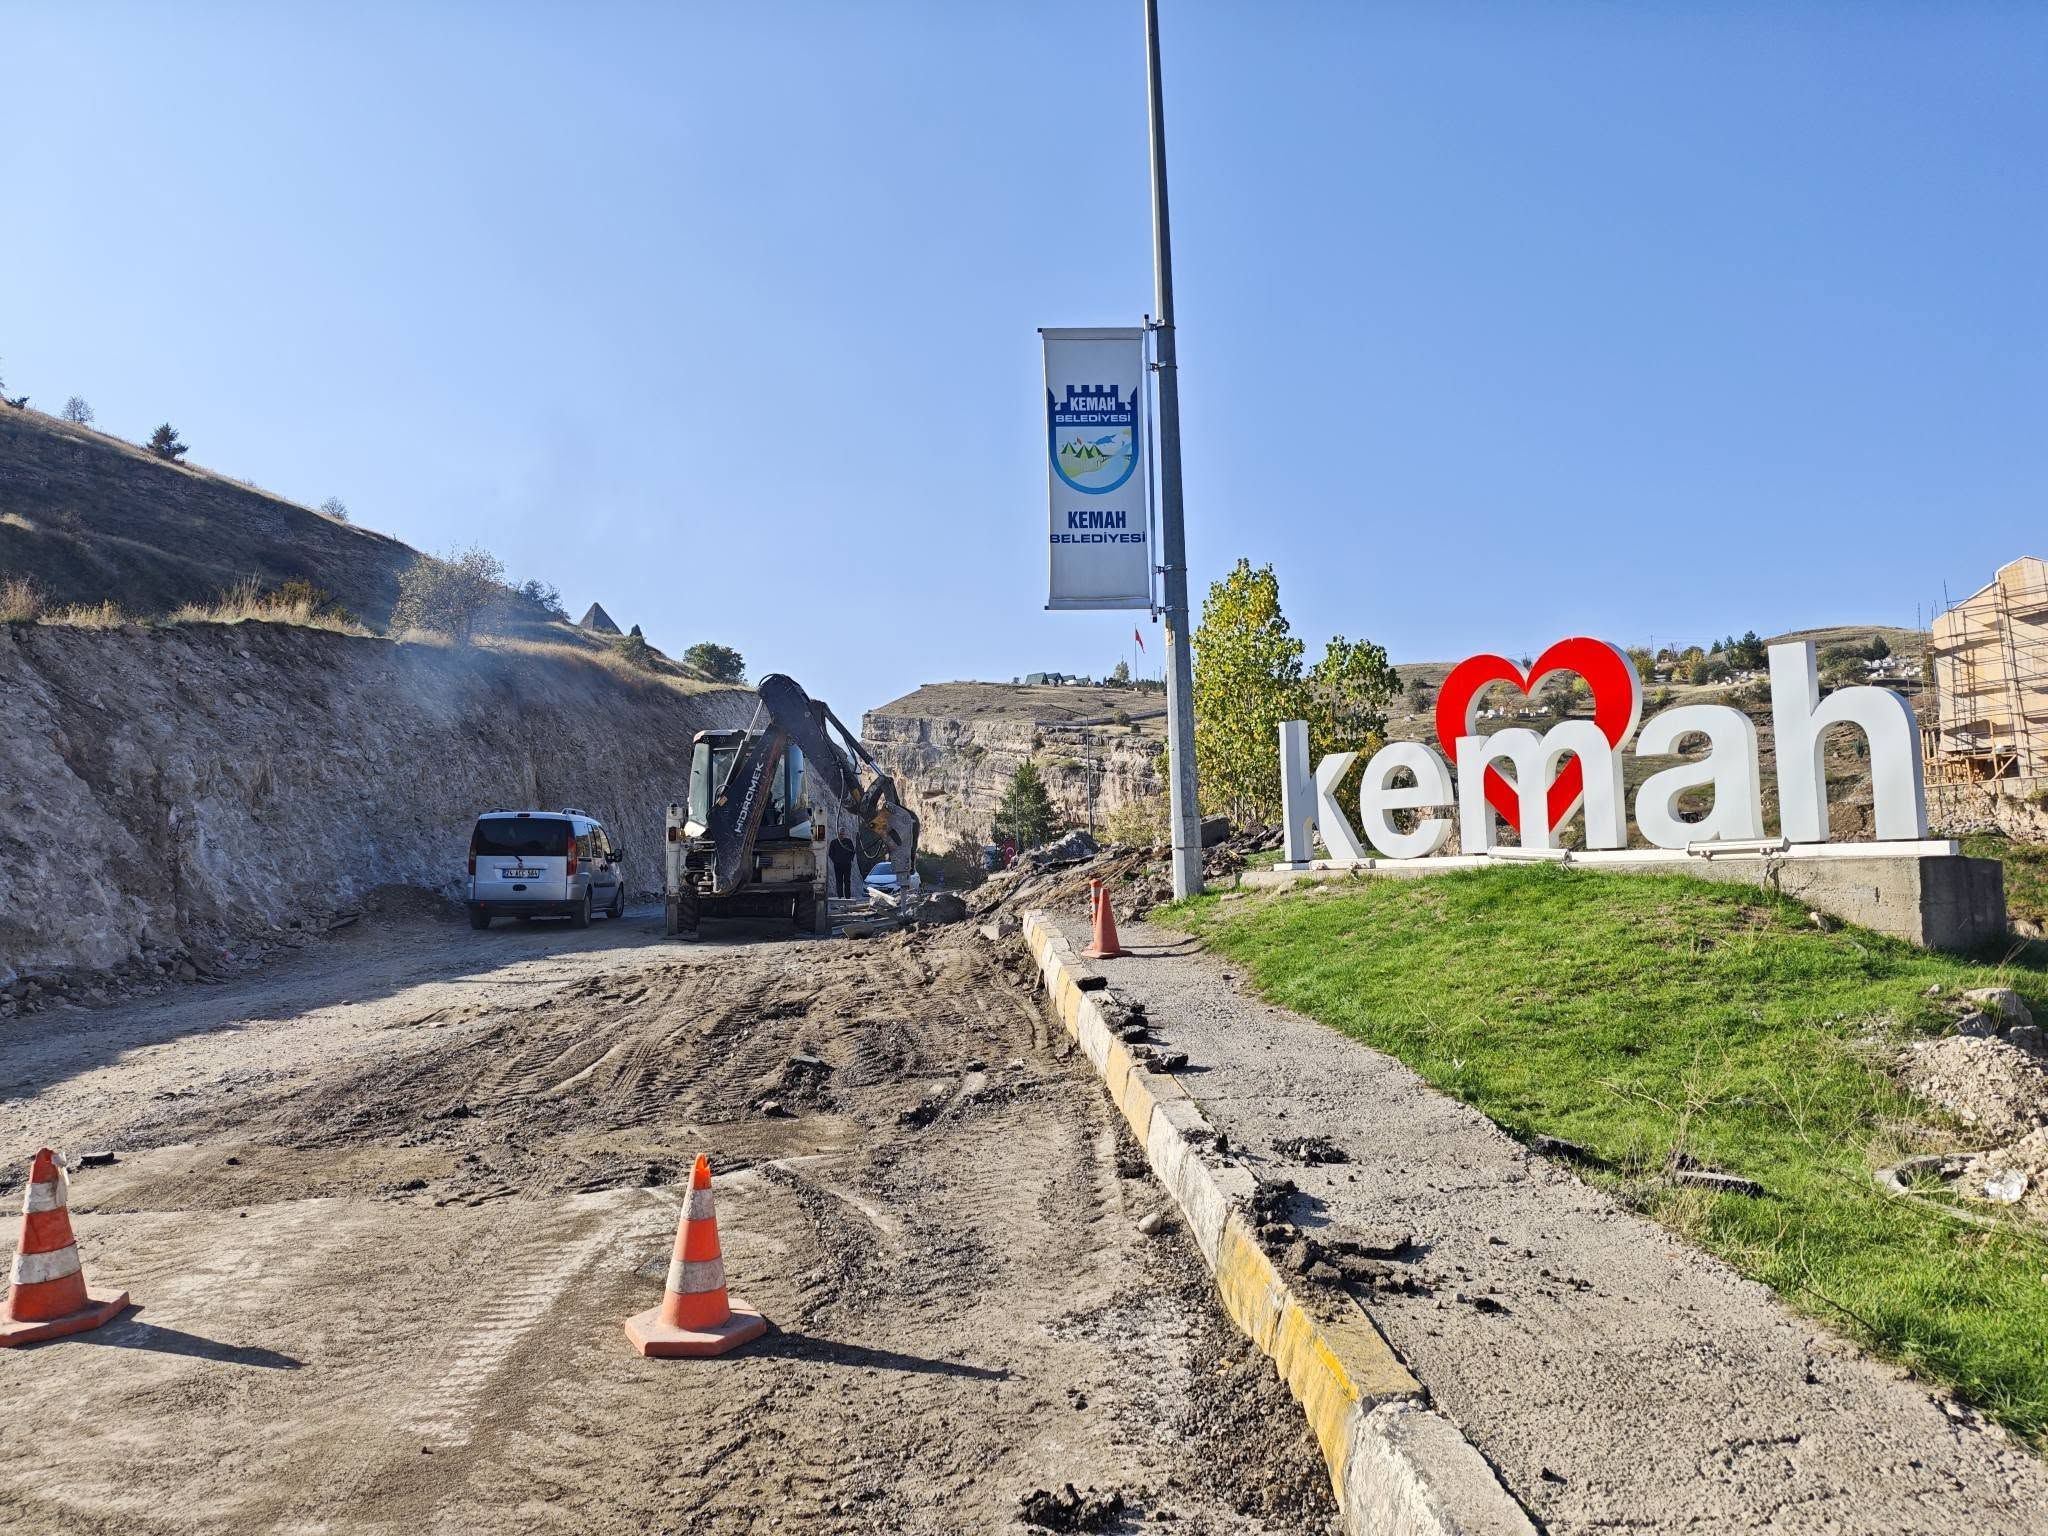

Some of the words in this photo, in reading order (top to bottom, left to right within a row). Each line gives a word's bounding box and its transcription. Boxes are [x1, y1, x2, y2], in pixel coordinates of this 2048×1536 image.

[1070, 397, 1116, 411] KEMAH
[1055, 412, 1131, 422] BELEDİYESİ
[1068, 511, 1126, 529] KEMAH
[1050, 531, 1146, 544] BELEDİYESİ
[1279, 640, 1928, 862] kemah
